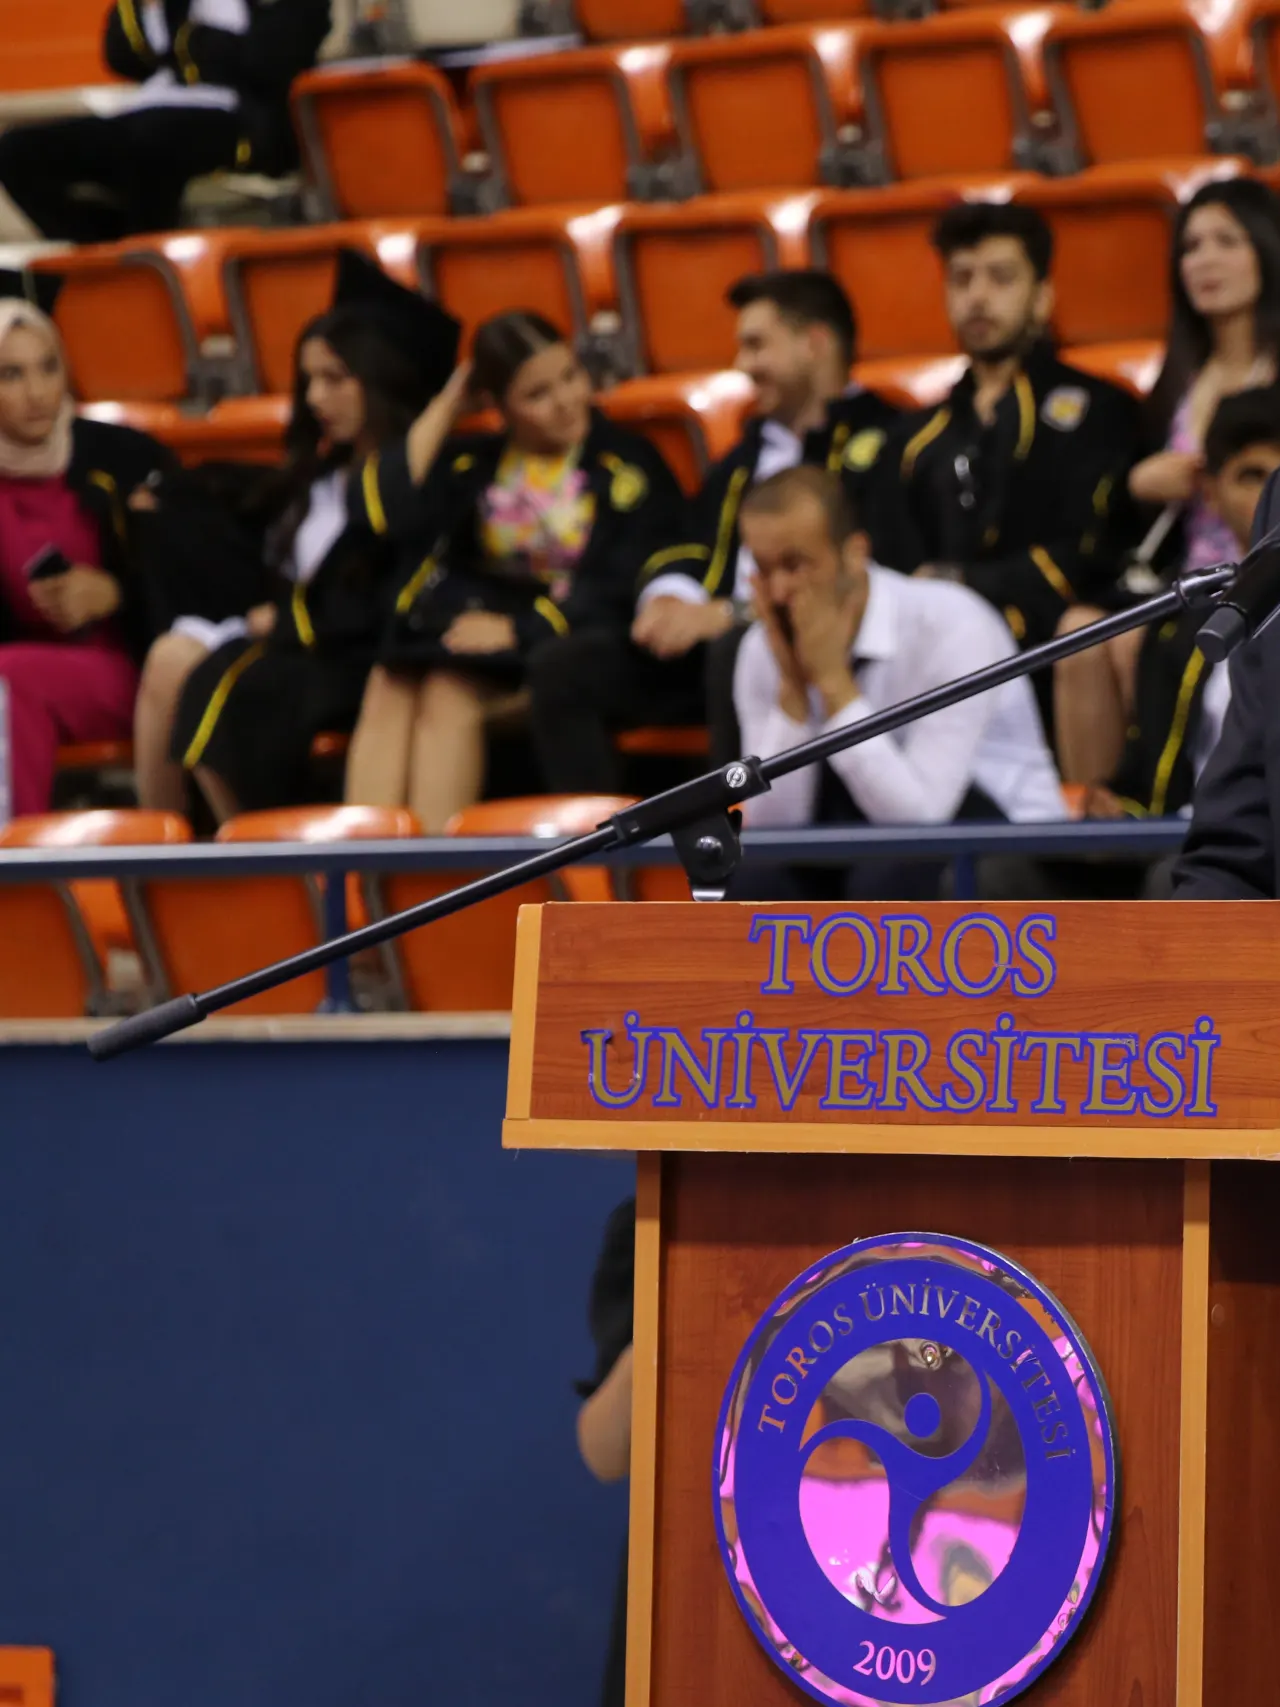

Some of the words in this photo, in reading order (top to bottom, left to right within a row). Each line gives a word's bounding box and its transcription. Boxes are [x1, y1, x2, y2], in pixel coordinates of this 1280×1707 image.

[751, 913, 1057, 996] TOROS
[758, 1302, 853, 1435] TOROS
[859, 1277, 1075, 1462] ÜNİVERSİTESİ
[852, 1640, 937, 1686] 2009
